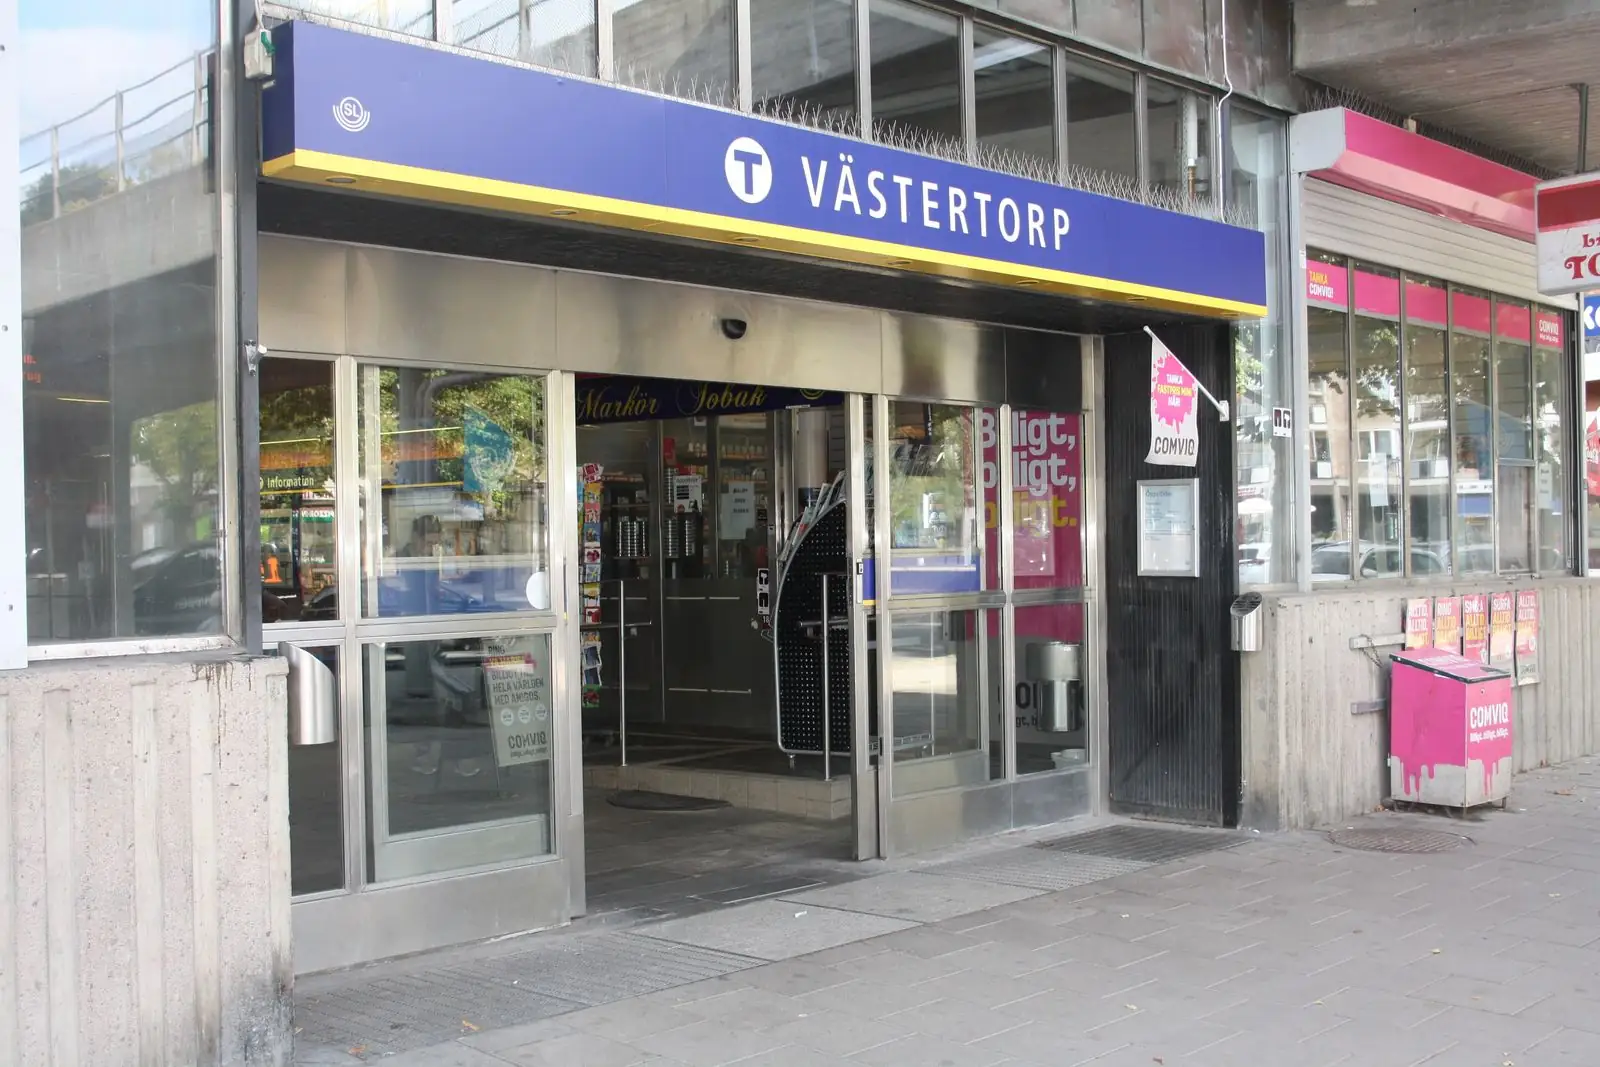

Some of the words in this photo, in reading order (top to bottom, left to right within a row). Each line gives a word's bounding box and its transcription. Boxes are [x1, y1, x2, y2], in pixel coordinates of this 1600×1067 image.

[344, 102, 360, 117] SL
[801, 153, 1070, 251] VÄSTERTORP
[1582, 233, 1600, 249] L
[1309, 270, 1328, 285] TANKA
[1309, 283, 1334, 298] COMVIQ!
[1166, 374, 1183, 385] TANKA
[980, 411, 1076, 455] Bligt,
[1154, 437, 1195, 456] COMVIQ
[267, 475, 315, 488] Information
[492, 681, 512, 693] HELA
[494, 694, 510, 705] MED
[1470, 702, 1509, 729] COMVIQ
[508, 731, 547, 749] COMVIQ
